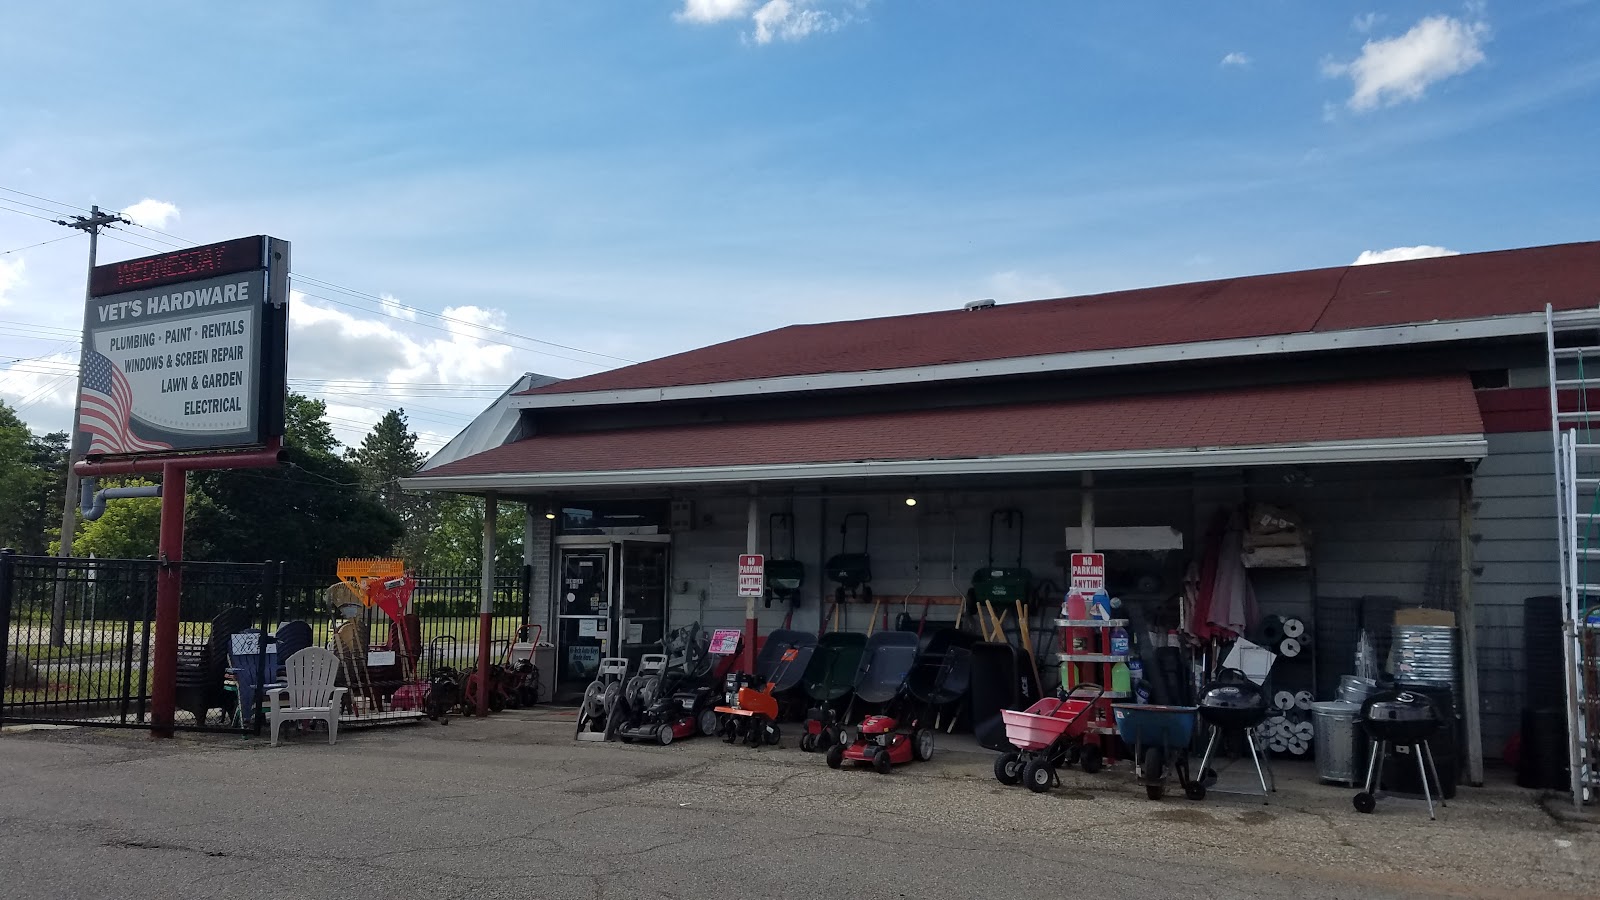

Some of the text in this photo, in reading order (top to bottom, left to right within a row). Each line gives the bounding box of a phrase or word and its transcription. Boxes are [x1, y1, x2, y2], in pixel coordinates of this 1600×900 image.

[118, 246, 225, 284] WEDNESDAY
[99, 282, 248, 322] VET'S HARDWARE
[110, 320, 244, 351] PLUMBING PAINT RENTALS
[125, 346, 243, 373] WINDOWS & SCREEN REPAIR
[161, 371, 242, 393] LAWN & GARDEN
[184, 397, 241, 415] ELECTRICAL
[748, 557, 755, 565] NO
[1073, 566, 1102, 575] PARKING
[1083, 557, 1092, 565] NO
[1074, 580, 1101, 588] ANYTIME
